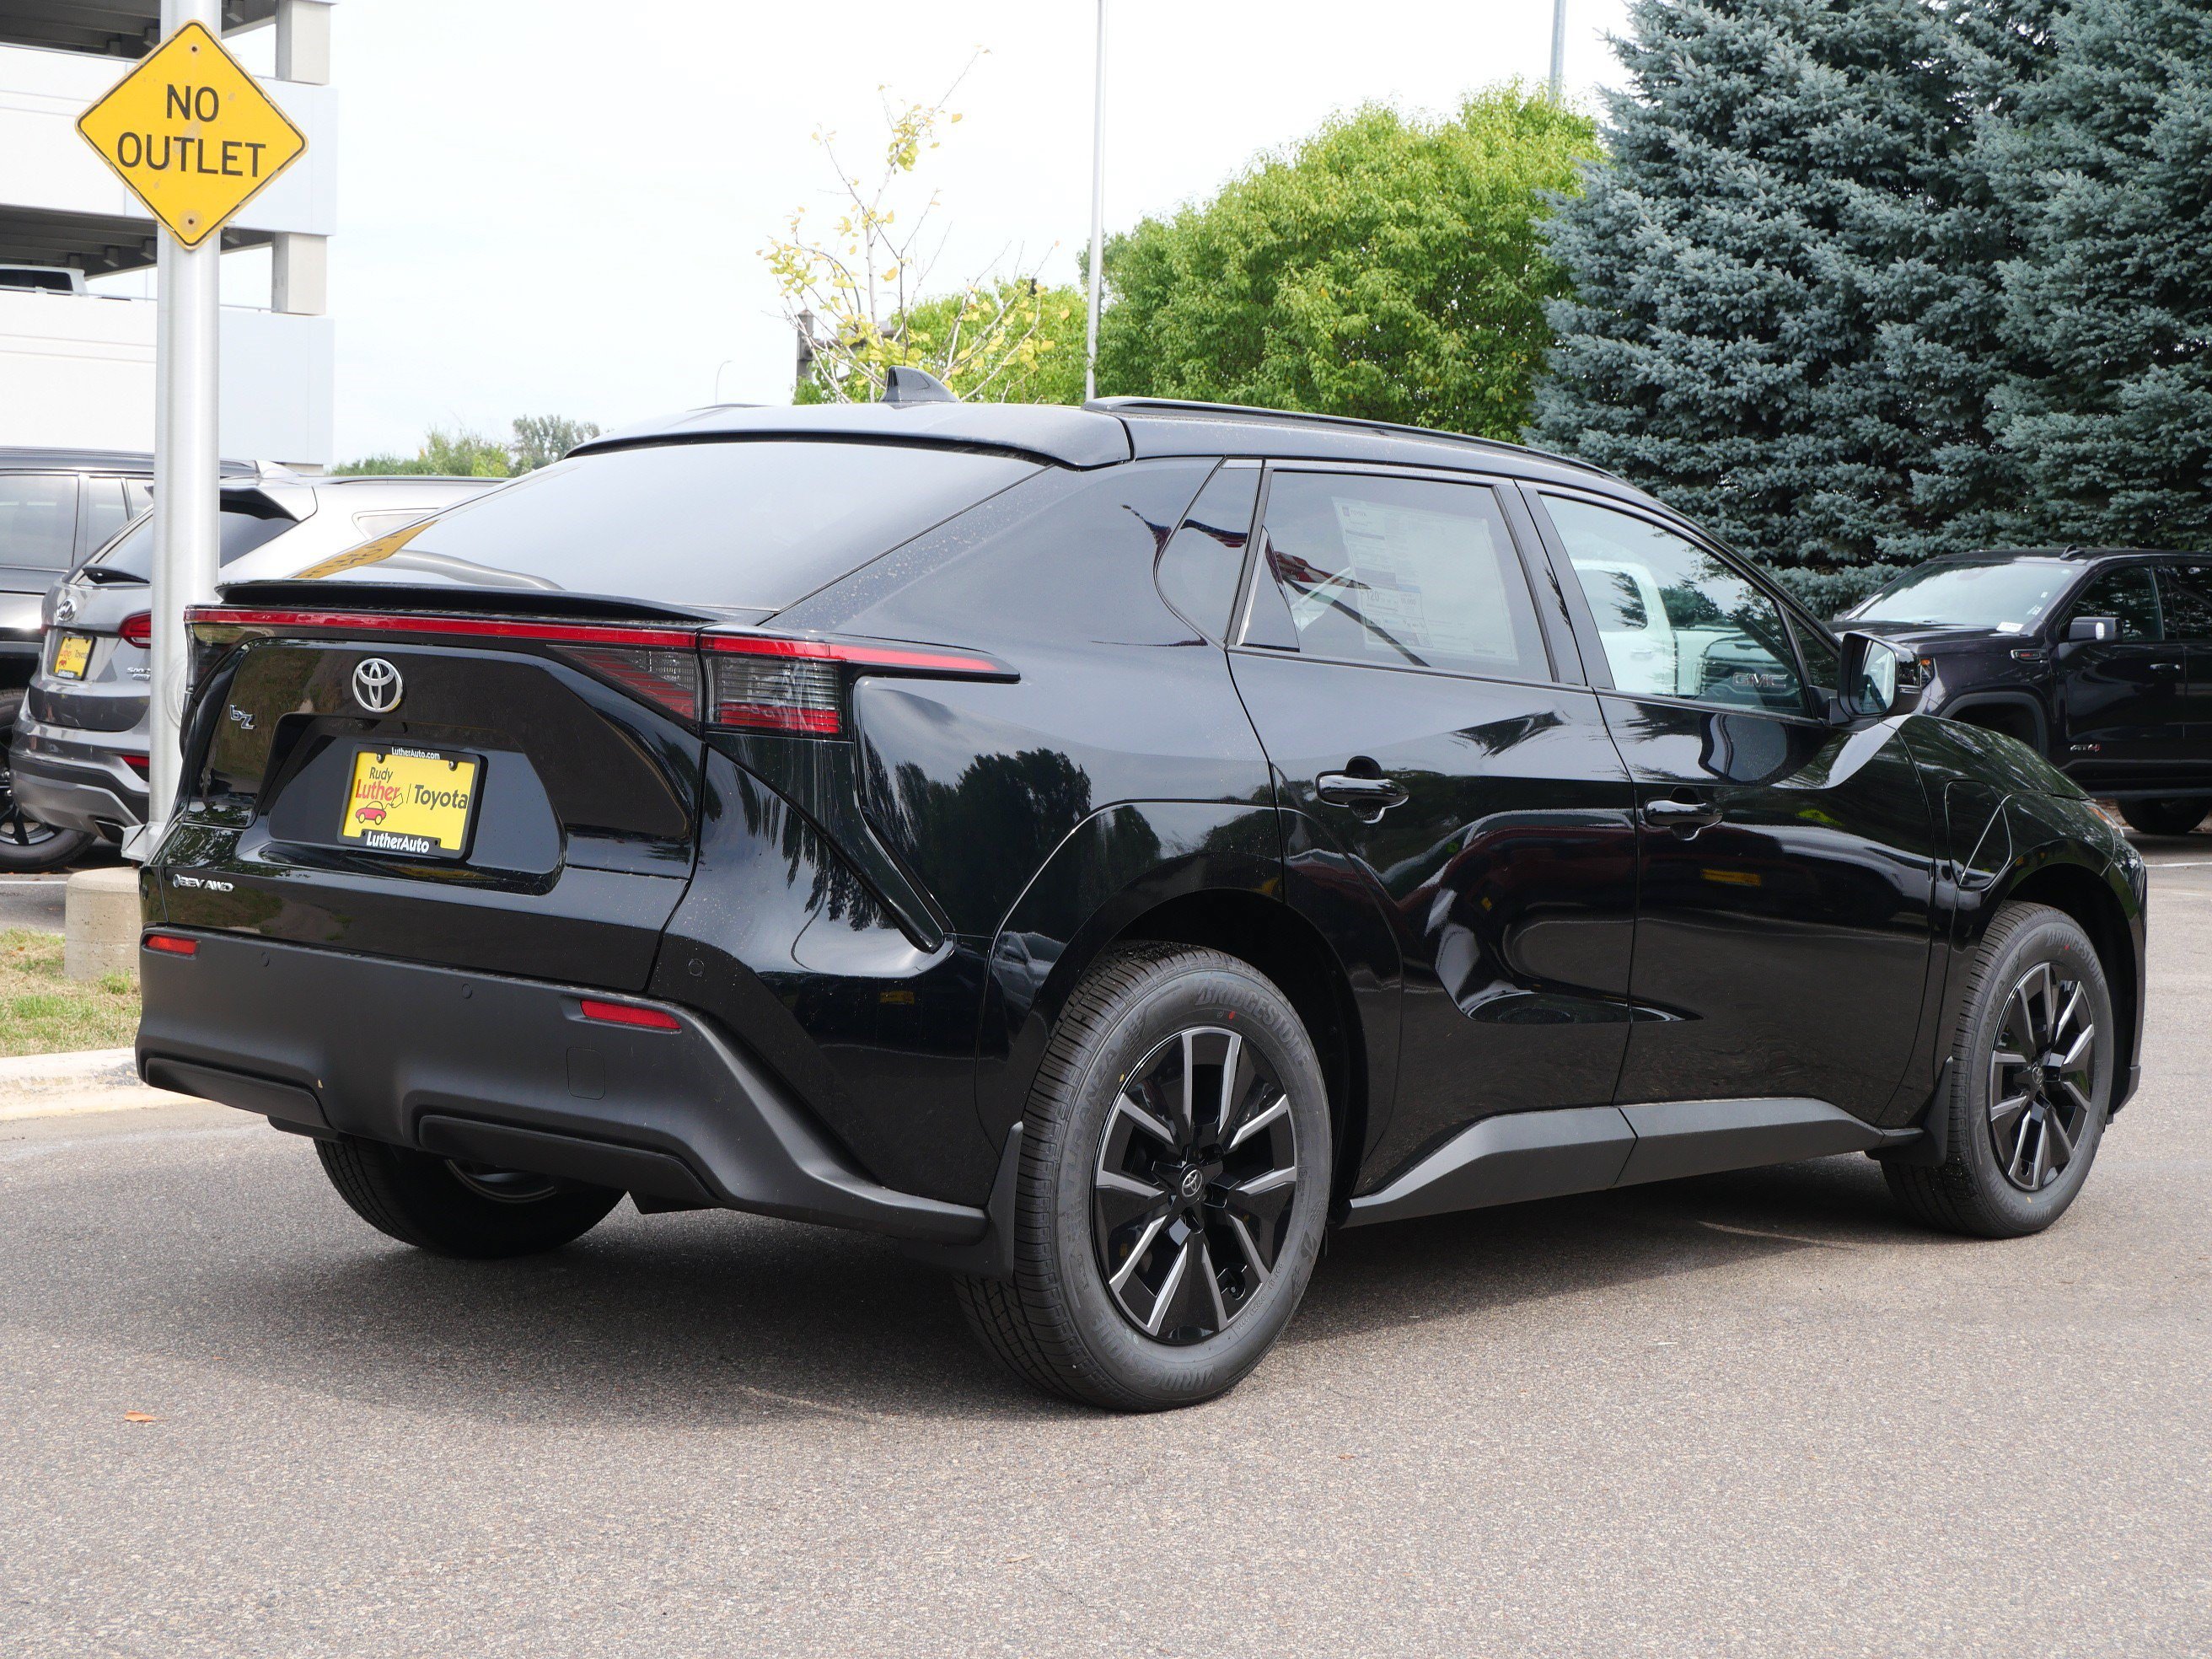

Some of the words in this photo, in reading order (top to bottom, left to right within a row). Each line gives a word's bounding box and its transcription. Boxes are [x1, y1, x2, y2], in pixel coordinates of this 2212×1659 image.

[167, 84, 219, 122] NO
[117, 132, 266, 178] OUTLET
[1732, 672, 1788, 688] GMC
[391, 746, 441, 760] LutherAuto.com
[368, 766, 394, 784] Rudy
[355, 778, 400, 802] Luther
[414, 784, 470, 811] Toyota
[366, 830, 431, 854] LutherAuto
[1195, 978, 1309, 1068] BRIDGESTONE
